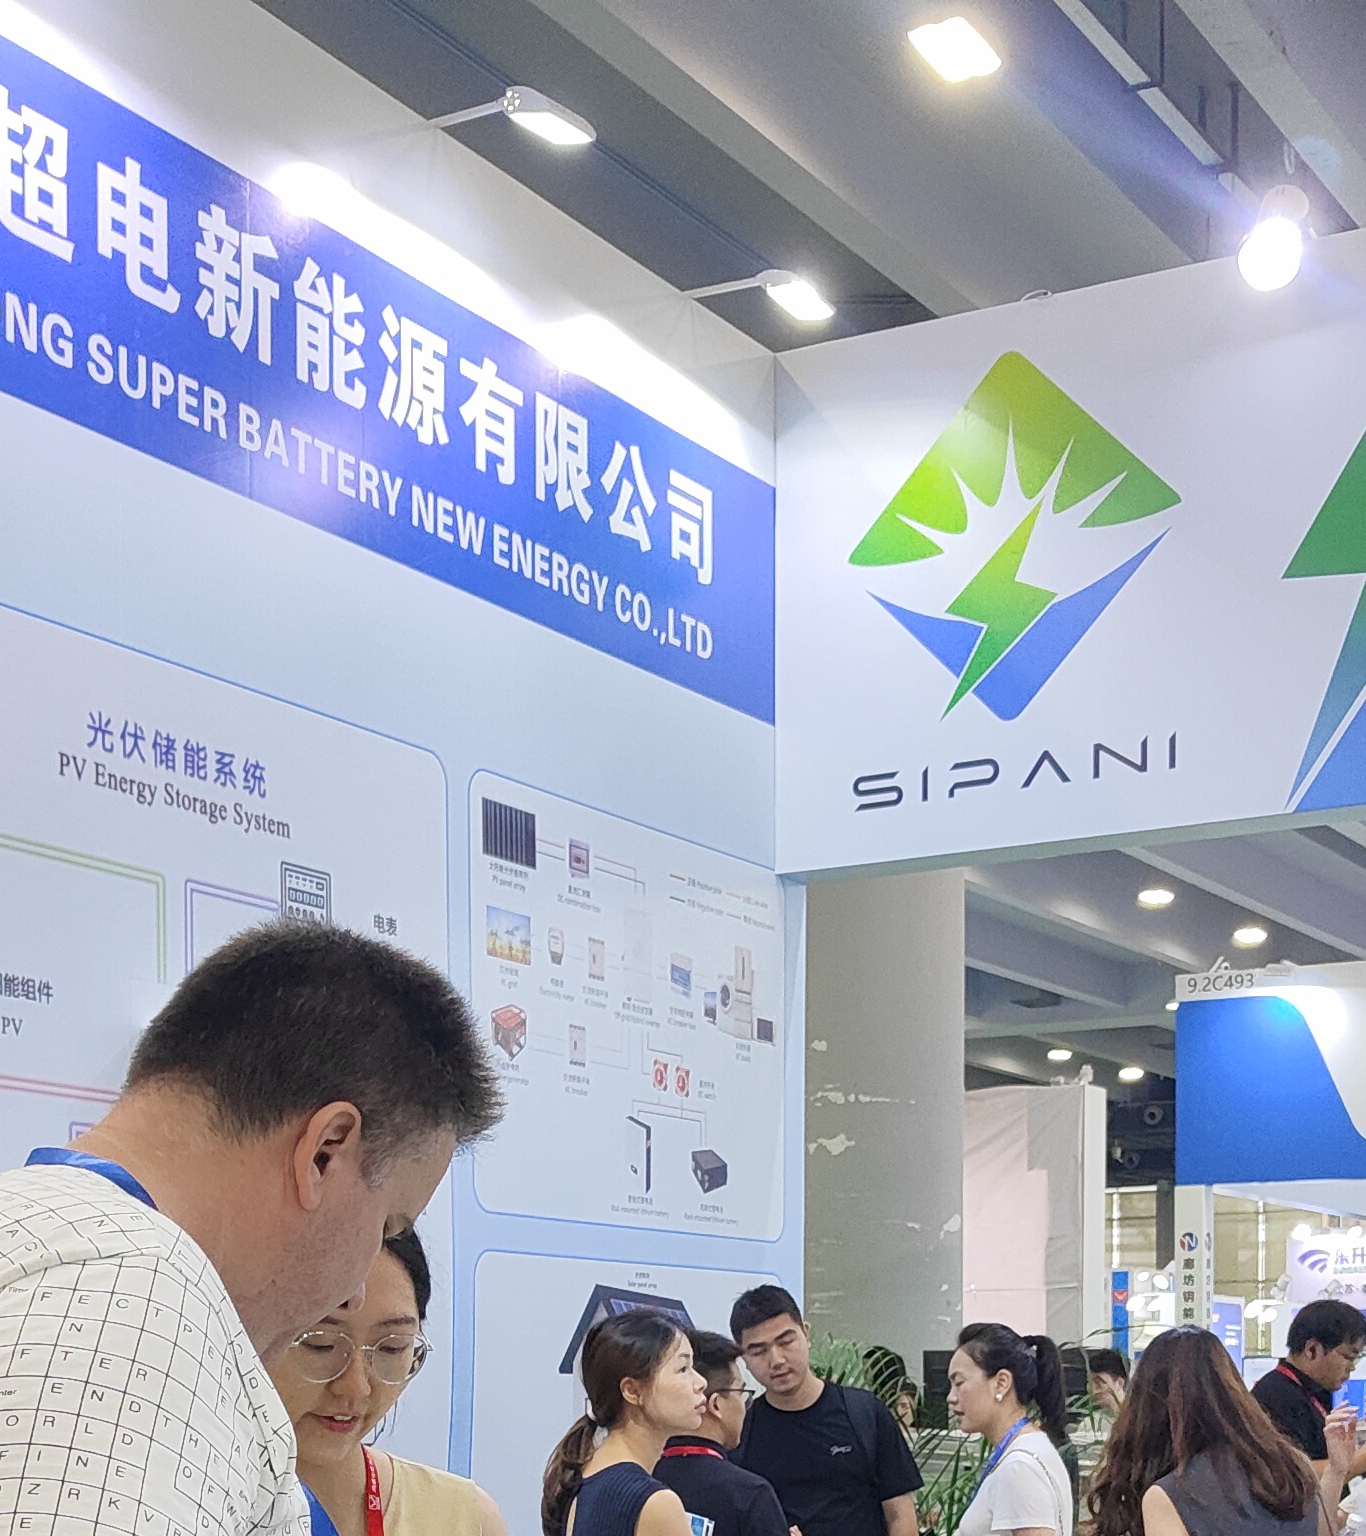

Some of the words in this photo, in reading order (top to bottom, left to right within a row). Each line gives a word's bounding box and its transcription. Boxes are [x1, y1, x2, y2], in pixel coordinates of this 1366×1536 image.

[86, 332, 229, 441] SUPER
[237, 399, 404, 517] BATTERY
[410, 481, 485, 556] NEW
[493, 521, 609, 614] ENERGY
[614, 582, 715, 661] CO.,LTD
[56, 751, 87, 780] PV
[93, 761, 158, 807] Energy
[163, 781, 228, 824] Storage
[233, 800, 291, 840] System
[86, 710, 268, 800] 光伏储能系统
[851, 730, 1178, 813] SIPANI
[373, 913, 398, 938] 电表
[1186, 972, 1255, 995] 9.2C493
[0, 1015, 24, 1038] PV
